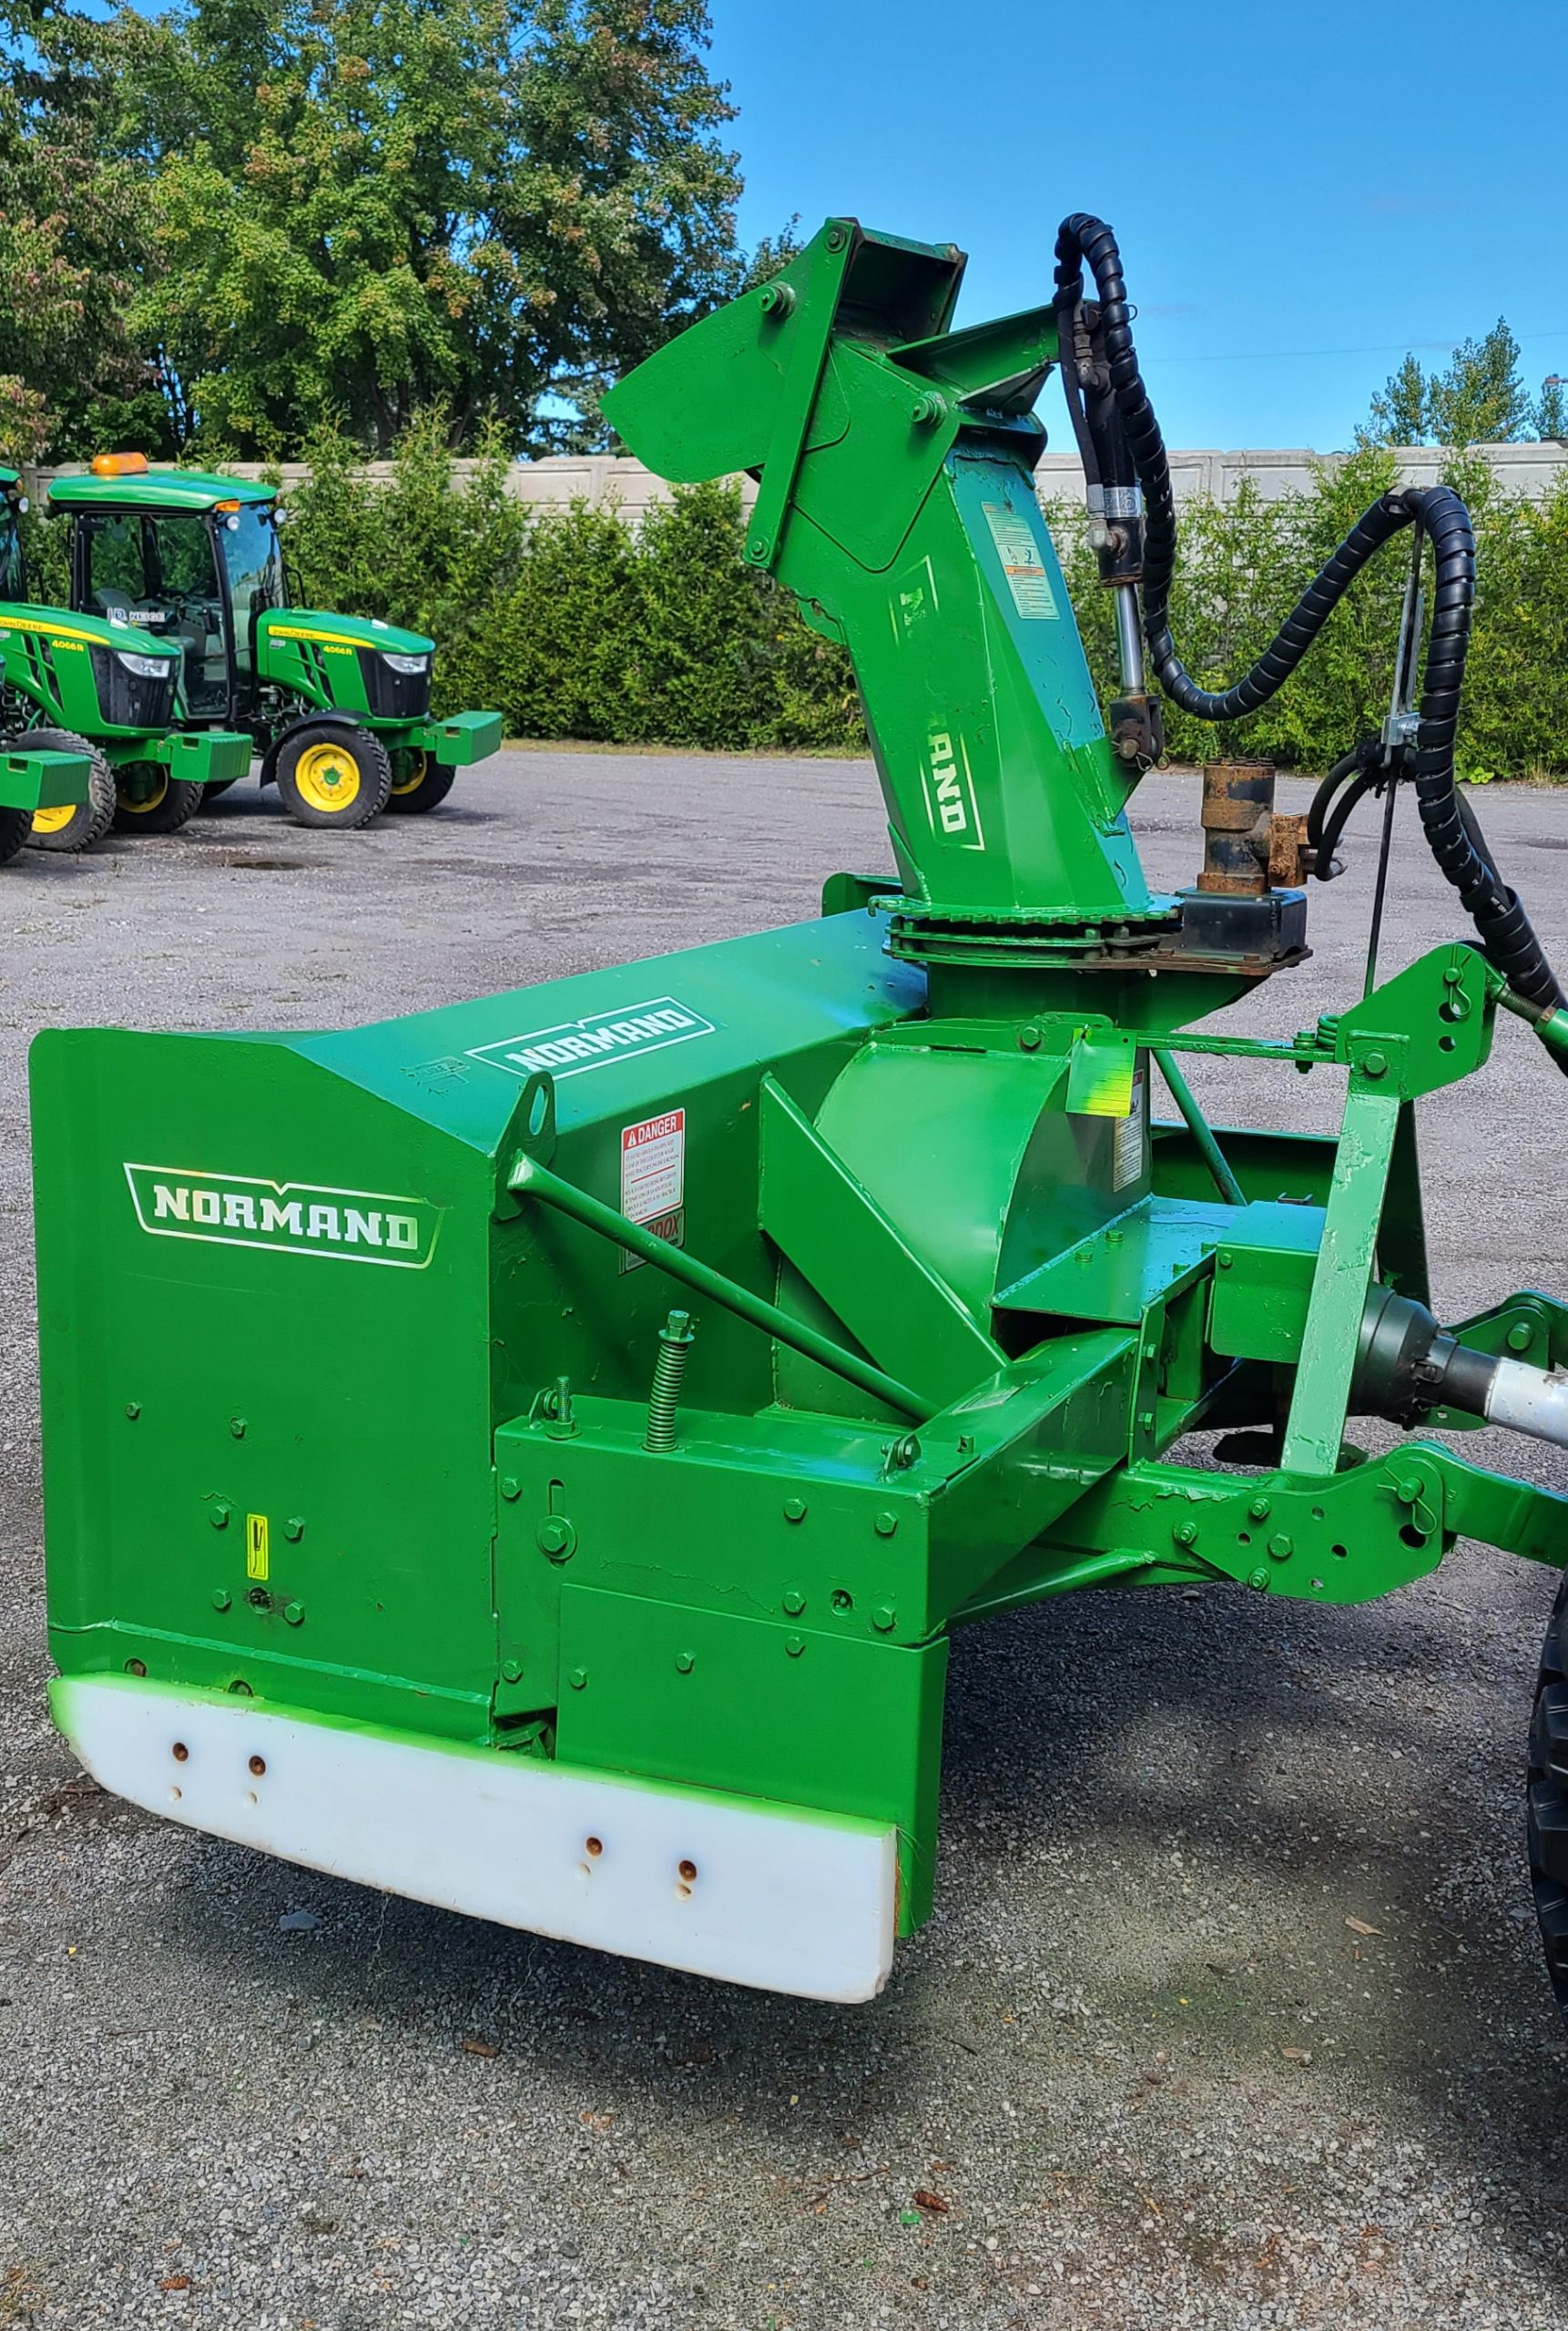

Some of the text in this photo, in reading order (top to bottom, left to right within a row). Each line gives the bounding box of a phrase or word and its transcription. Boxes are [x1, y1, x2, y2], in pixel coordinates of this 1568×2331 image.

[504, 1008, 696, 1072] NORMAND
[638, 1115, 677, 1145] DANGER
[153, 1185, 419, 1250] NORMAND
